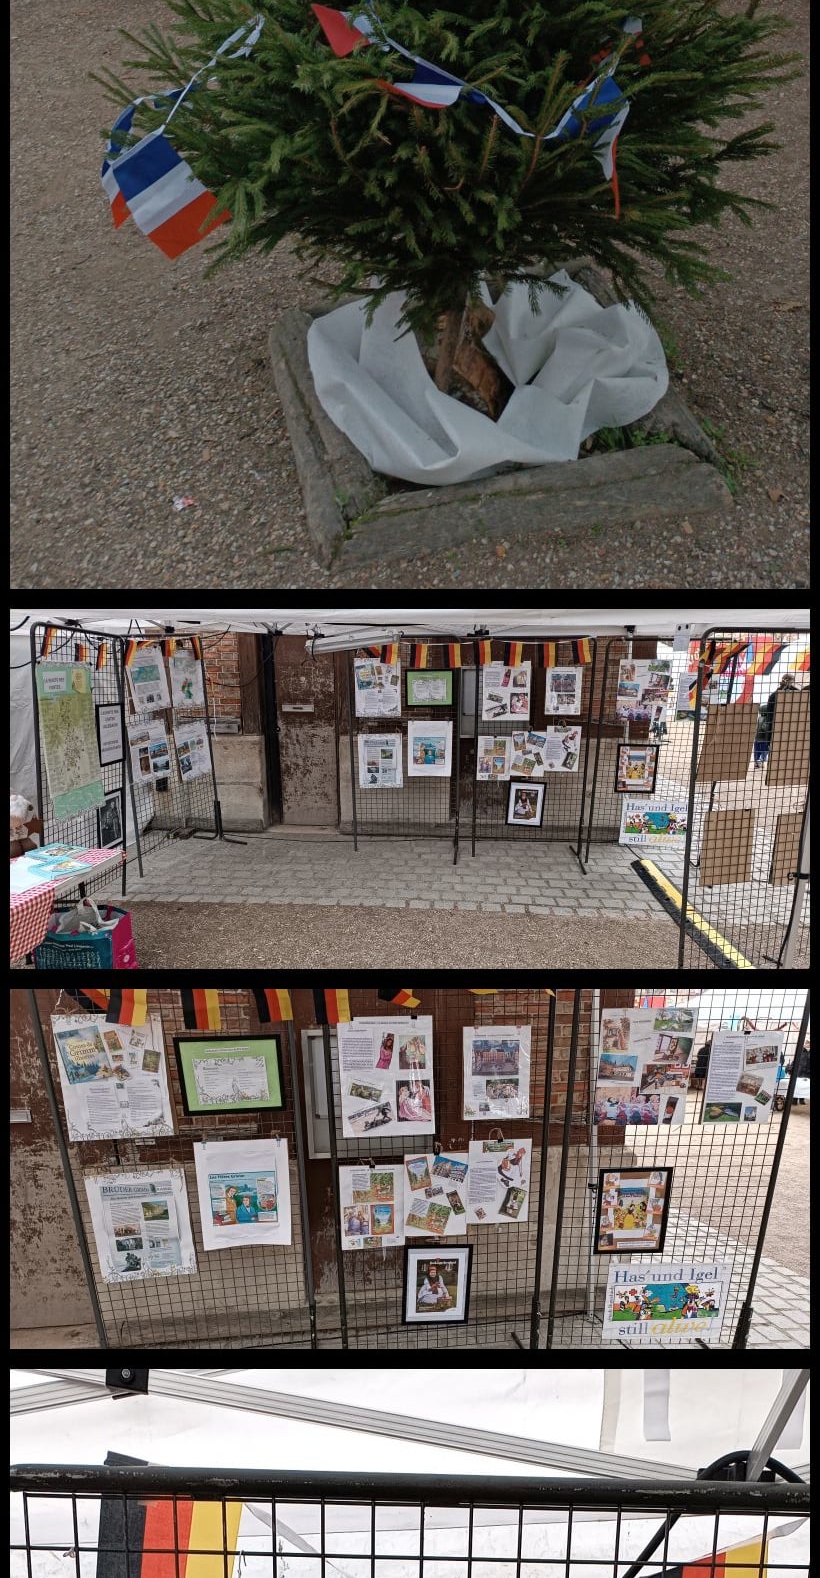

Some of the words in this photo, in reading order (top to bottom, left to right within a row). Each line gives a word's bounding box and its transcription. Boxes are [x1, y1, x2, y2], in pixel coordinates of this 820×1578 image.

[648, 802, 667, 811] und
[652, 1269, 683, 1281] und
[689, 1267, 718, 1283] Igel
[619, 1322, 648, 1335] still
